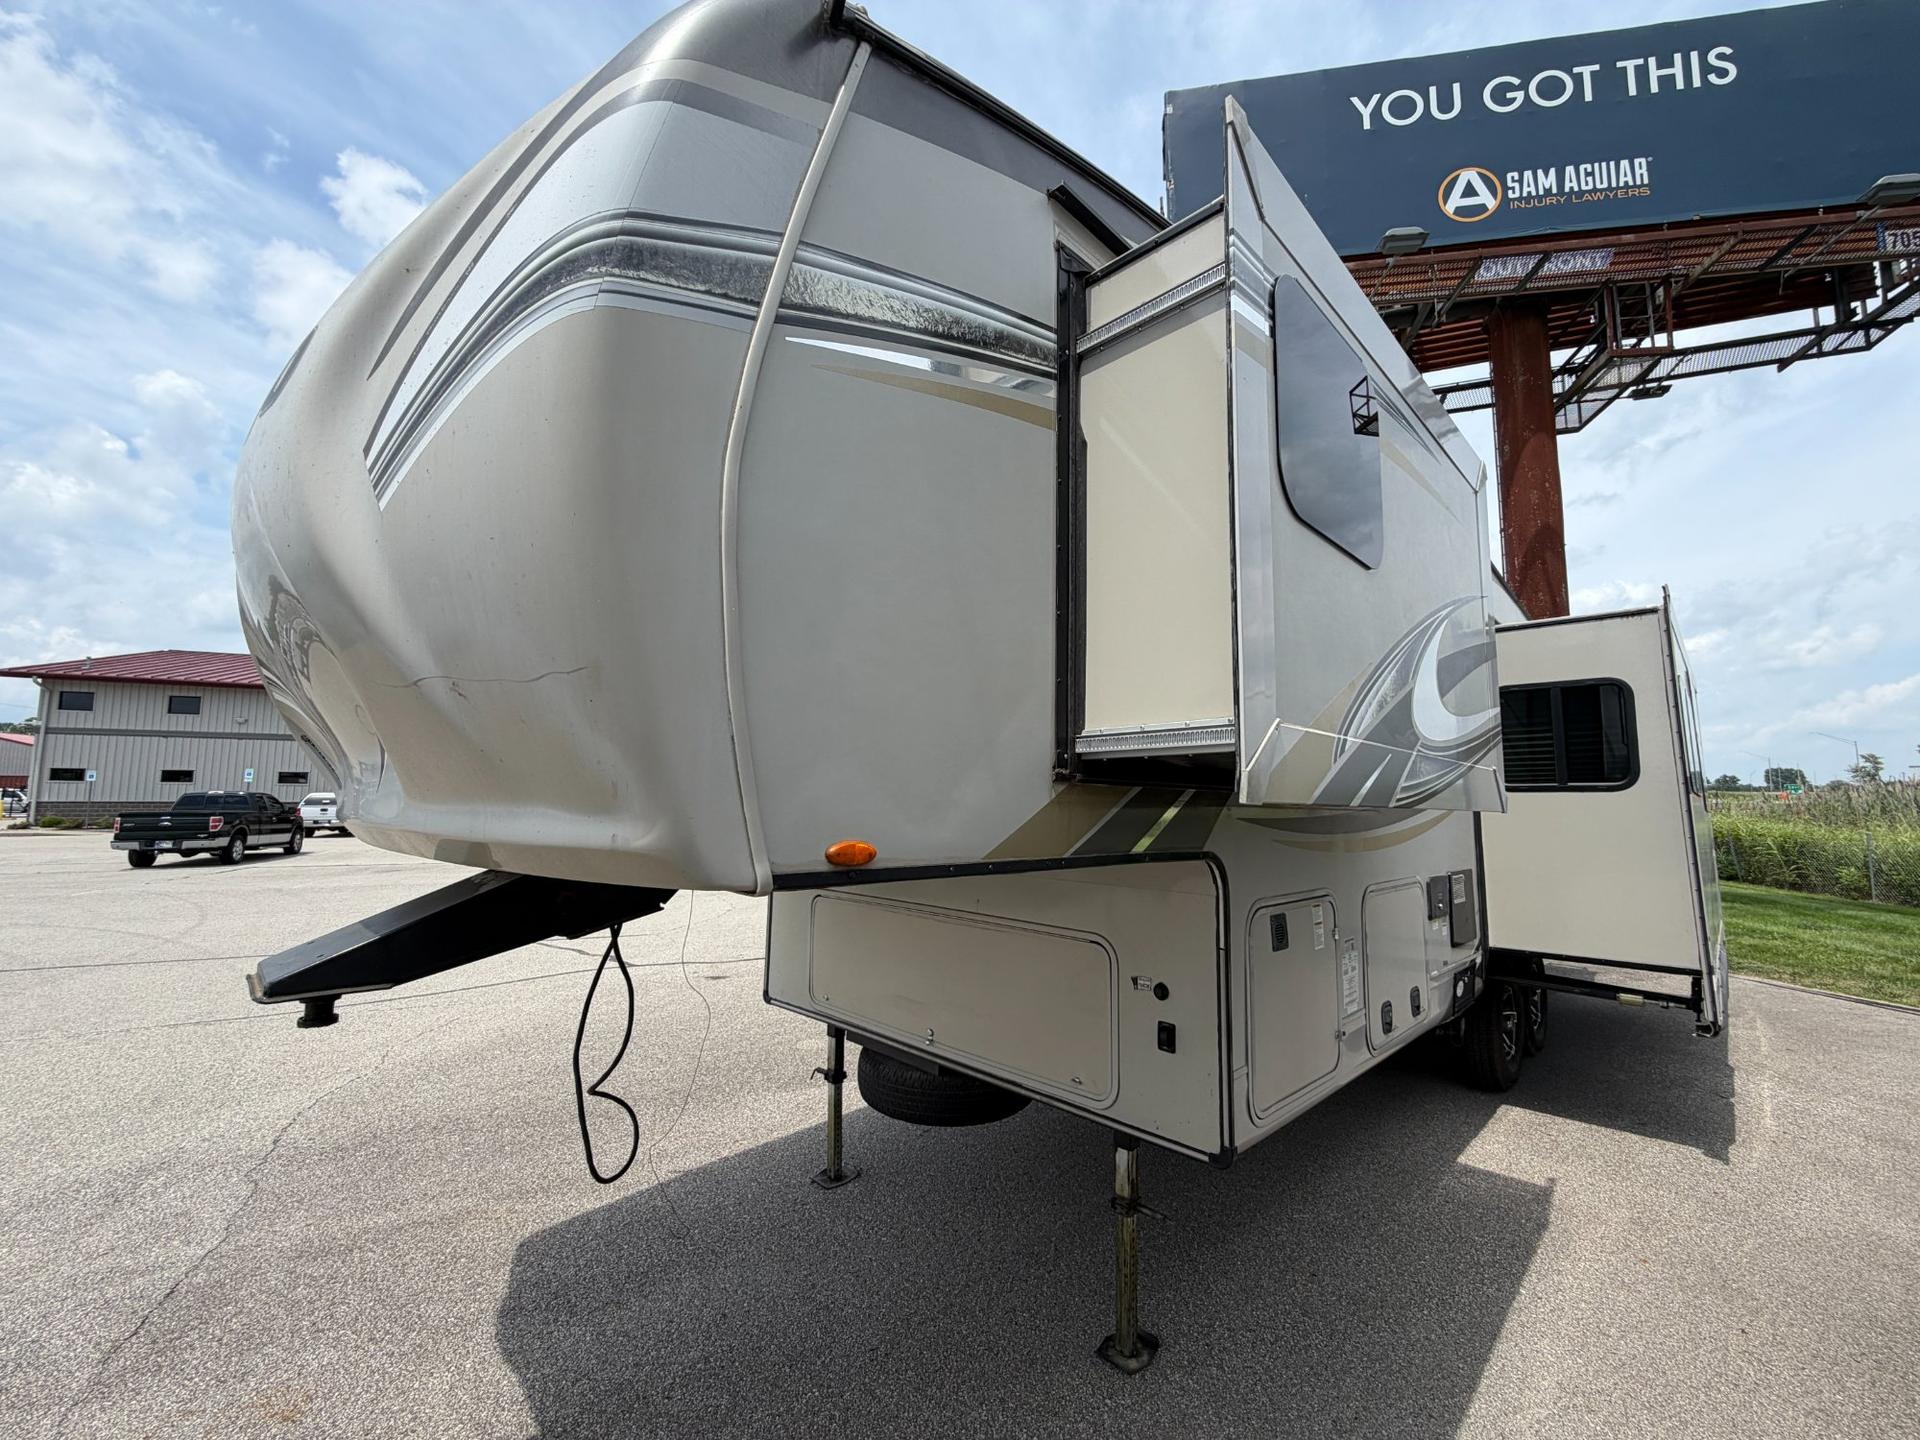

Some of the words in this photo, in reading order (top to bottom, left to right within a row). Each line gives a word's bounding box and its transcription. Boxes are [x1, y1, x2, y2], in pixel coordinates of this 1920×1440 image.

[1350, 82, 1462, 130] YOU
[1482, 64, 1600, 113] GOT
[1616, 46, 1738, 97] THIS
[1506, 167, 1558, 199] SAM
[1564, 157, 1650, 193] AGUIAR
[1509, 195, 1567, 209] INJURY
[1572, 187, 1651, 204] LAWYERS
